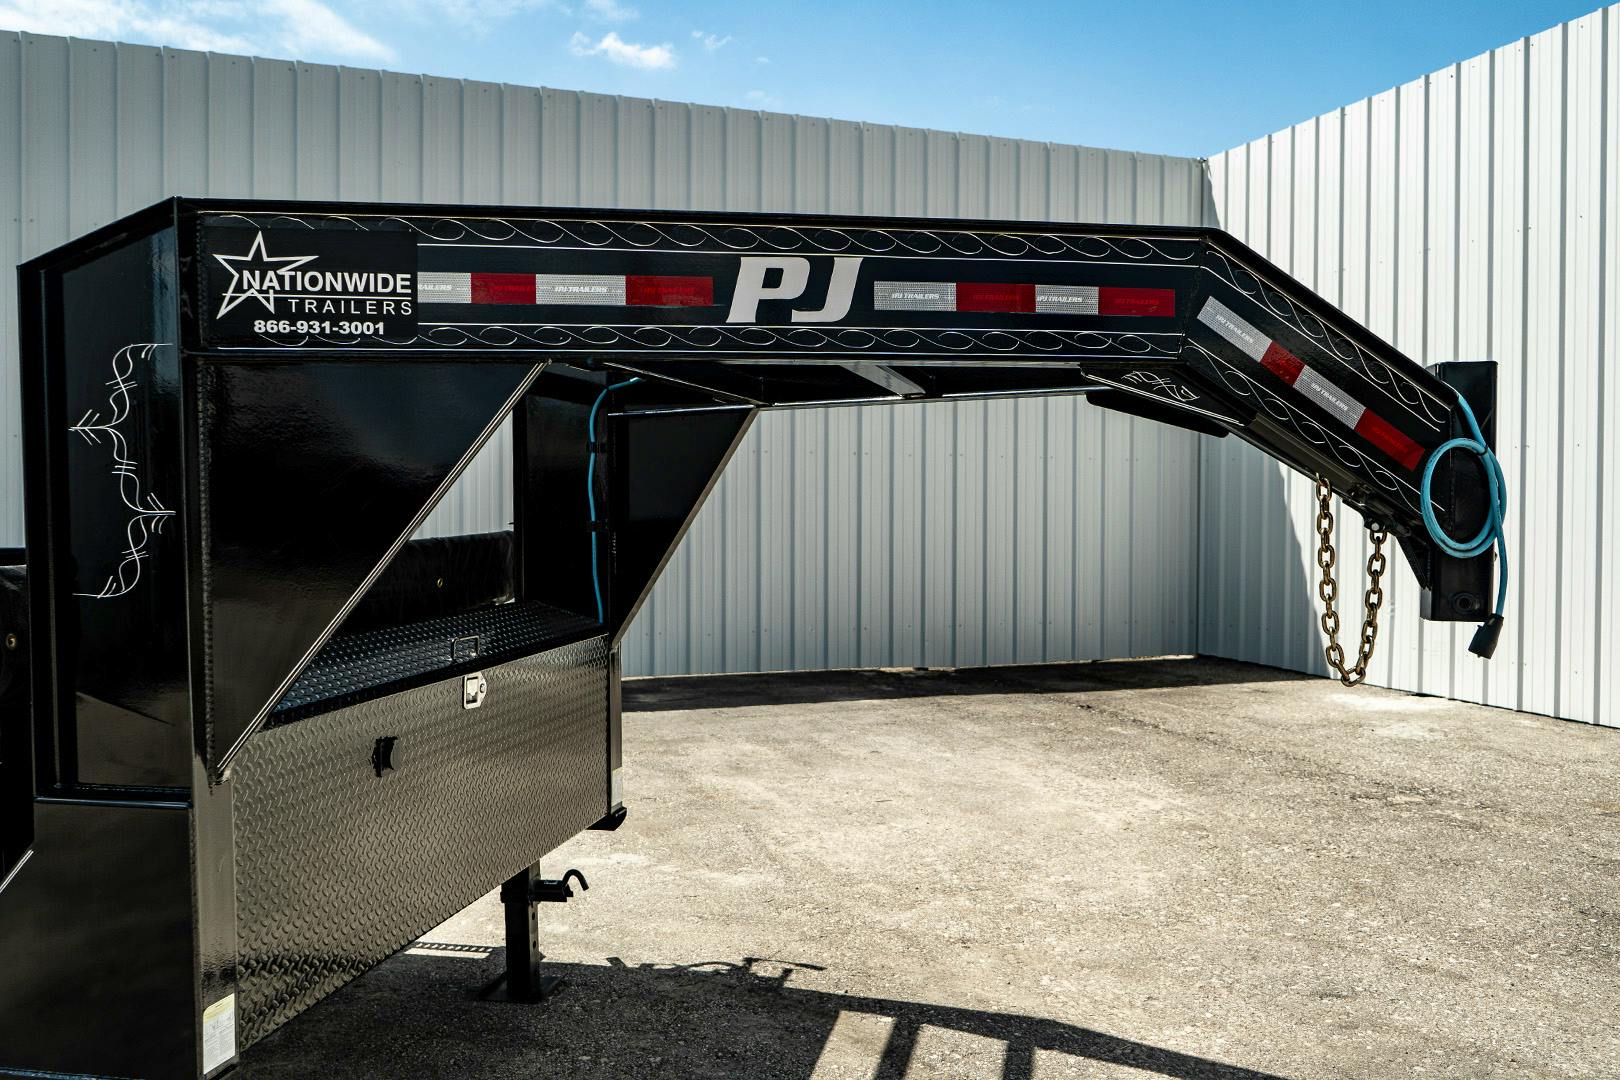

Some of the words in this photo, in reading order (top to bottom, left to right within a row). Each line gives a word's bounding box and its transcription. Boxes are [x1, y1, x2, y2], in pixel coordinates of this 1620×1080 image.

[242, 270, 412, 293] NATIONWIDE
[725, 256, 864, 323] PJ
[903, 292, 940, 300] TRAILERS
[1048, 295, 1083, 303] TRAILERS
[287, 299, 412, 315] TRAILERS
[253, 319, 385, 335] 866-931-3001
